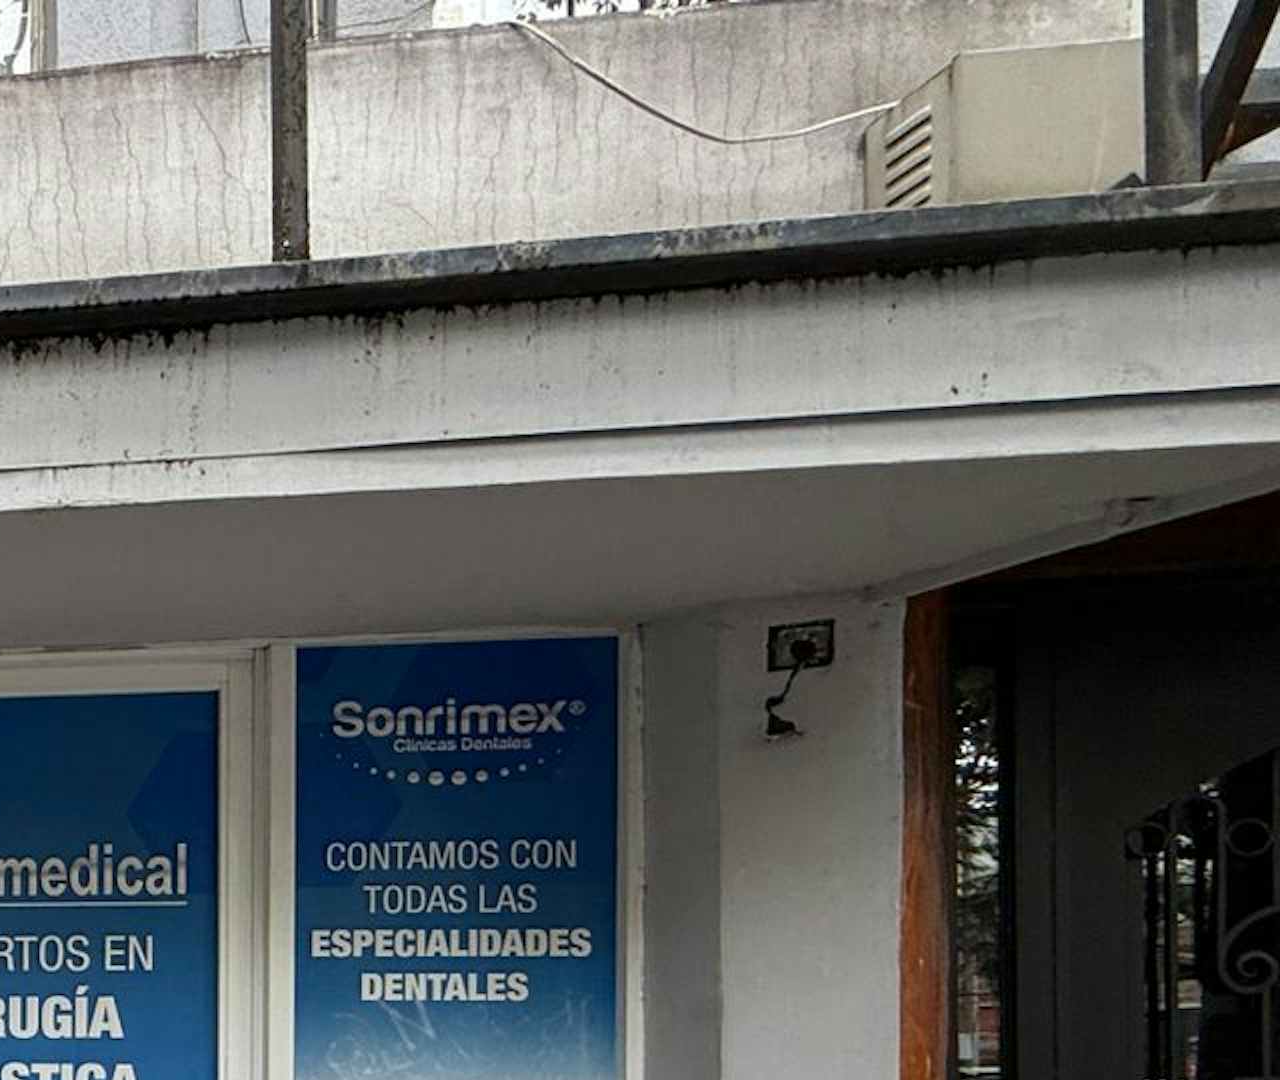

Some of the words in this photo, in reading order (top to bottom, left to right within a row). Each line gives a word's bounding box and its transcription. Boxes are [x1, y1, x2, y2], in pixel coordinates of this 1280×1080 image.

[461, 736, 533, 751] Dentales
[326, 840, 500, 872] CONTAMOS
[510, 838, 577, 869] CON
[363, 884, 468, 913] TODAS
[478, 883, 538, 912] LAS
[104, 935, 154, 972] EN
[311, 928, 592, 958] ESPECIALIDADES
[360, 972, 530, 1002] DENTALES
